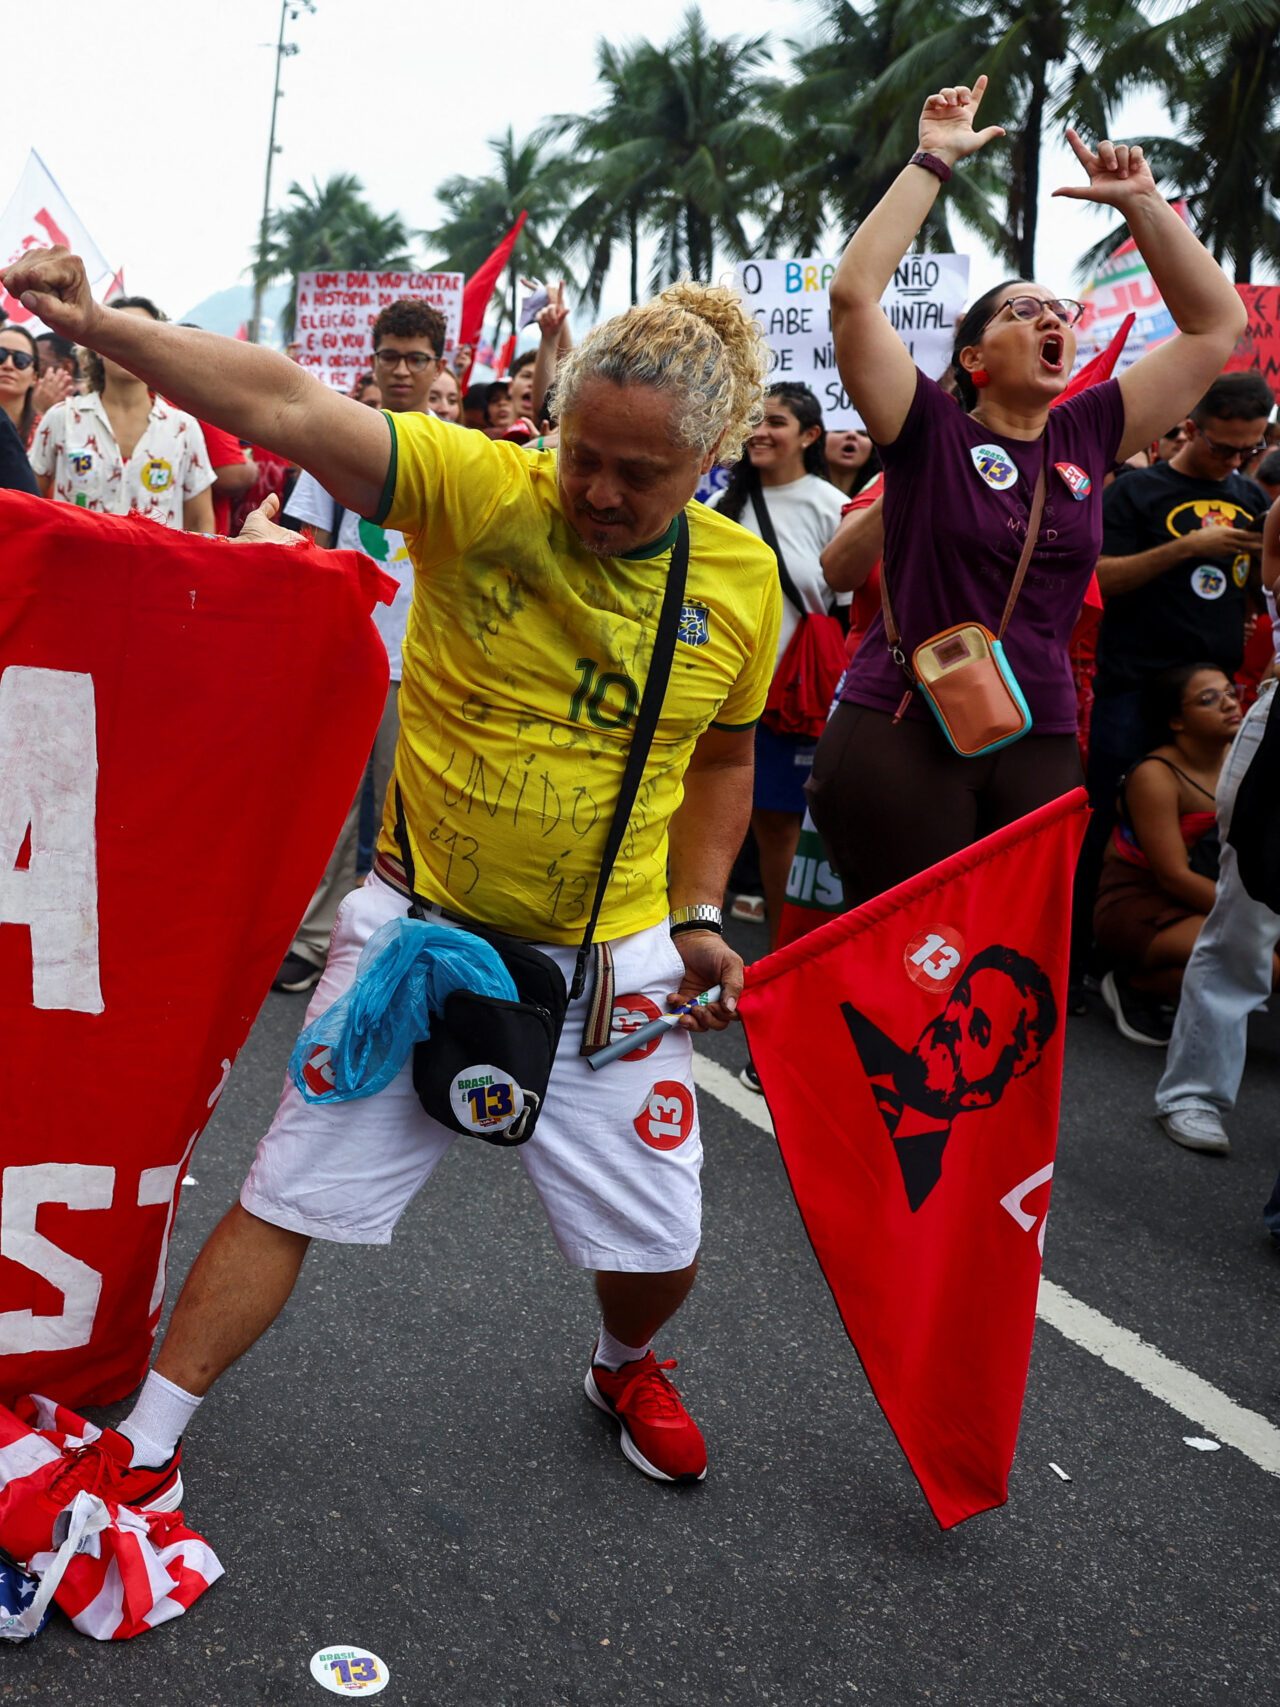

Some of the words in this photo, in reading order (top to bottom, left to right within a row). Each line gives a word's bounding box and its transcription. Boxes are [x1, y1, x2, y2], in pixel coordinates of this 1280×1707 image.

[315, 273, 339, 289] UM
[742, 264, 762, 295] O
[785, 262, 836, 294] BRA
[894, 257, 940, 289] NÃO
[980, 457, 1015, 484] 13
[568, 656, 640, 731] 10
[909, 933, 961, 982] 13
[458, 1074, 495, 1091] BRASIL
[467, 1083, 514, 1121] 13
[648, 1093, 683, 1140] 13
[319, 1651, 358, 1662] BRASIL
[329, 1657, 378, 1684] 13
